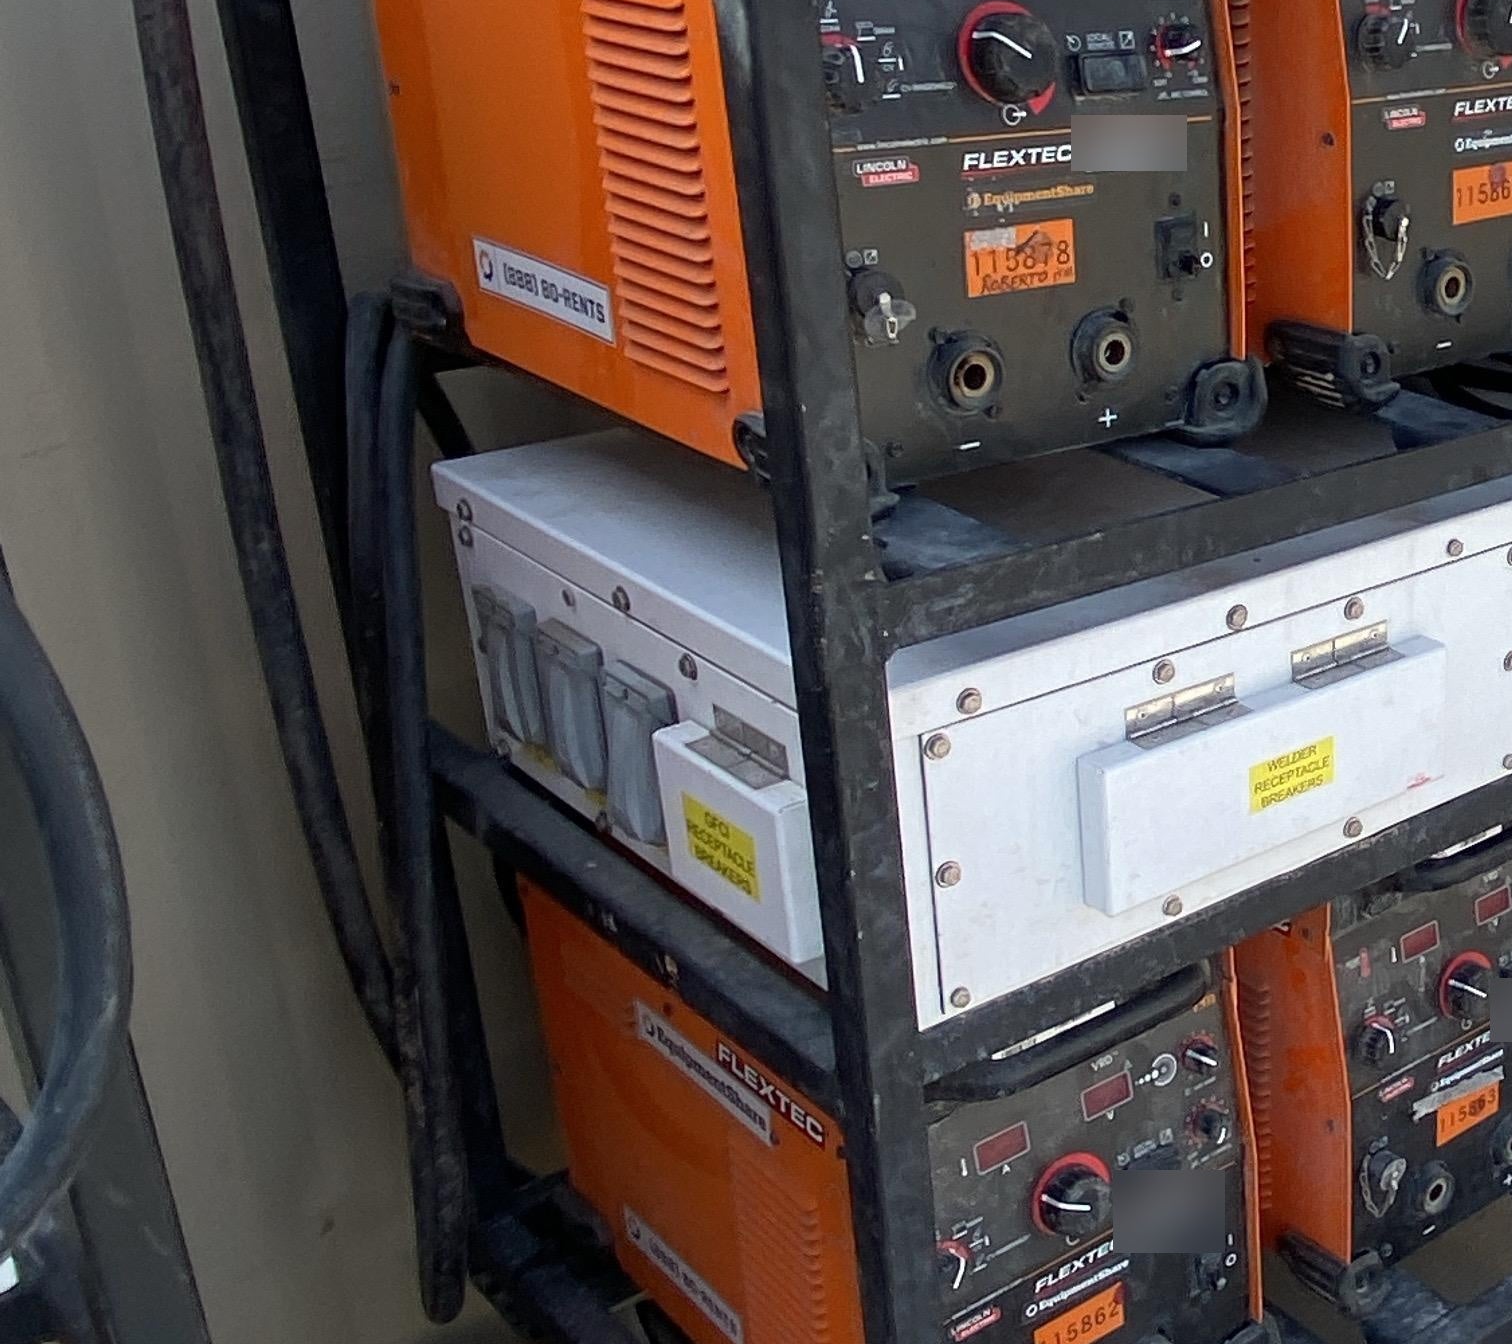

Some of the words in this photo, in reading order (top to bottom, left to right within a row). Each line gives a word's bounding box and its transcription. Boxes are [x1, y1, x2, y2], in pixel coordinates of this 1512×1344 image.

[856, 159, 907, 175] LINCOLN
[962, 144, 1072, 171] FLEXTEC
[1266, 744, 1317, 772] WELDER
[1253, 755, 1330, 794] RECEPTACLE
[1260, 773, 1323, 808] BREAKERS
[717, 1042, 824, 1143] FLEXTEC
